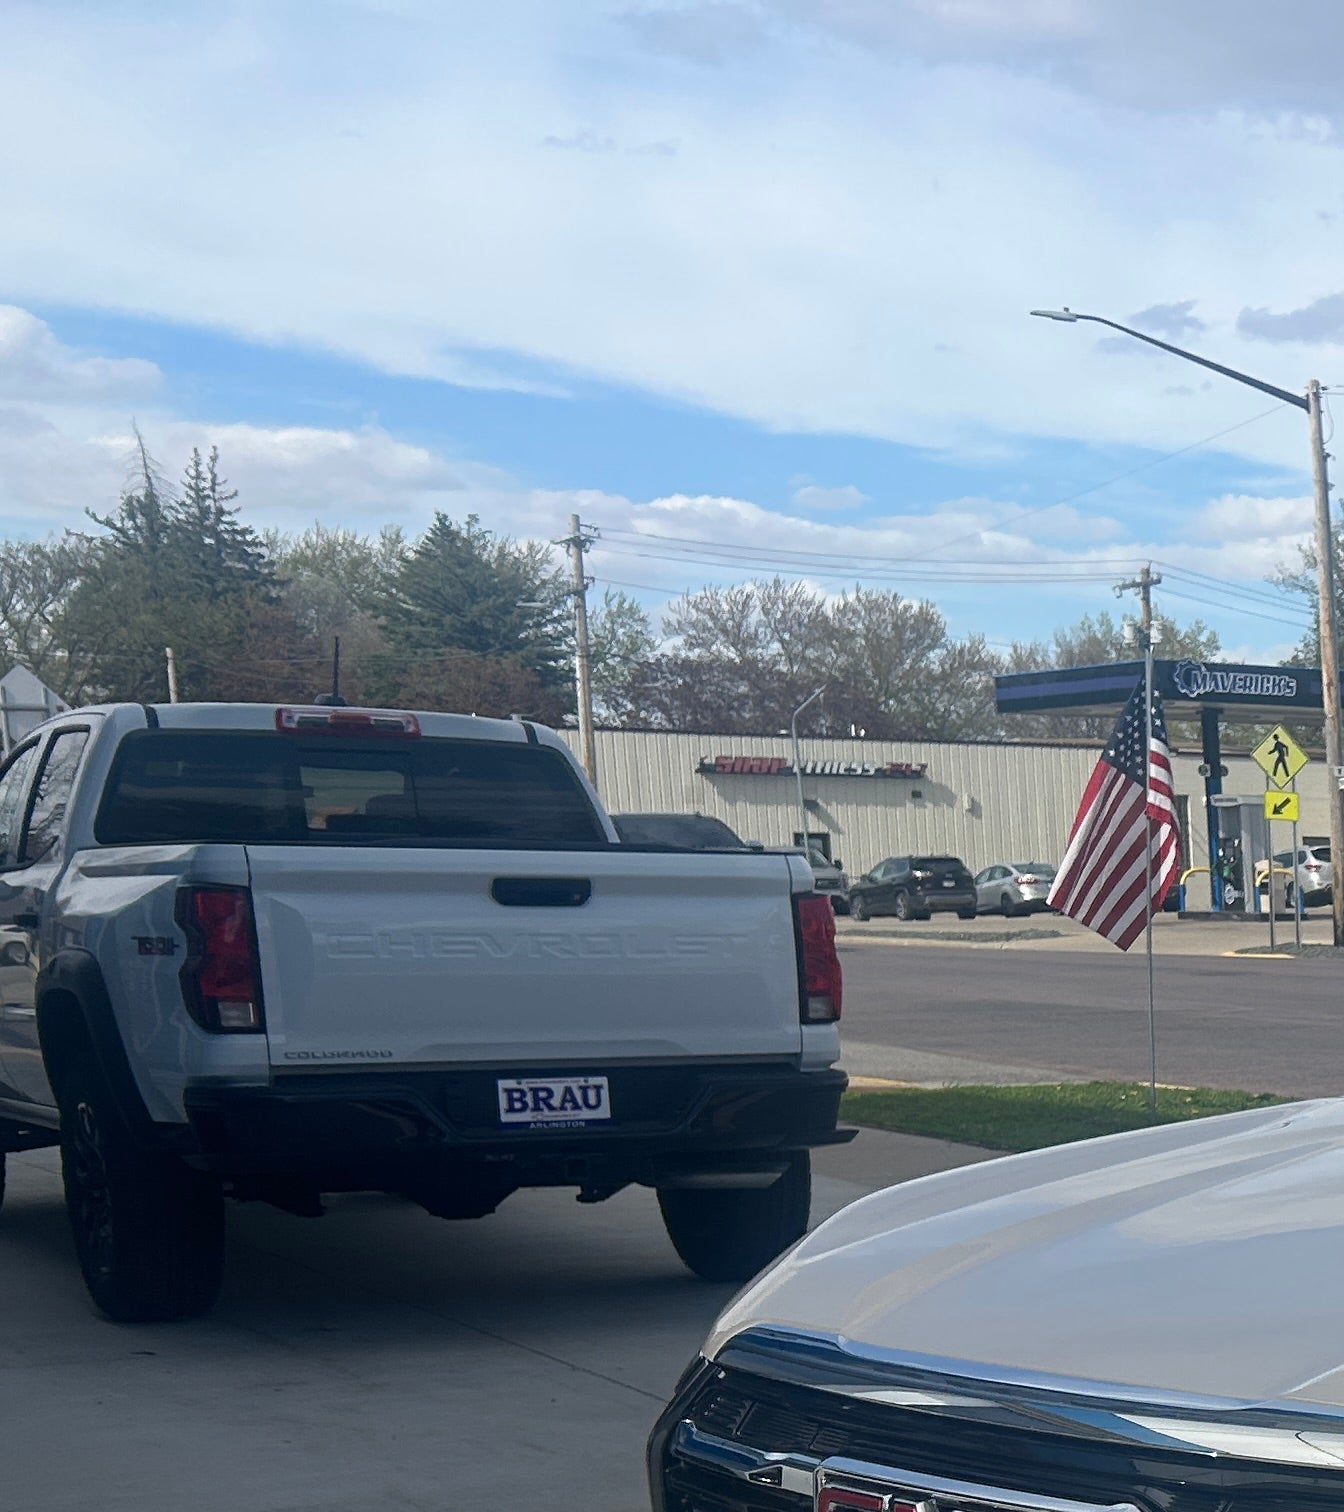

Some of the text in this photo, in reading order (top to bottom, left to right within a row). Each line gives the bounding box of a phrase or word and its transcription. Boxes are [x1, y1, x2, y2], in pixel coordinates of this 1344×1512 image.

[327, 931, 750, 959] CHEVROLET
[284, 1050, 393, 1060] COLORADO
[502, 1084, 603, 1113] BRAU
[529, 1120, 586, 1129] ARLINGTON
